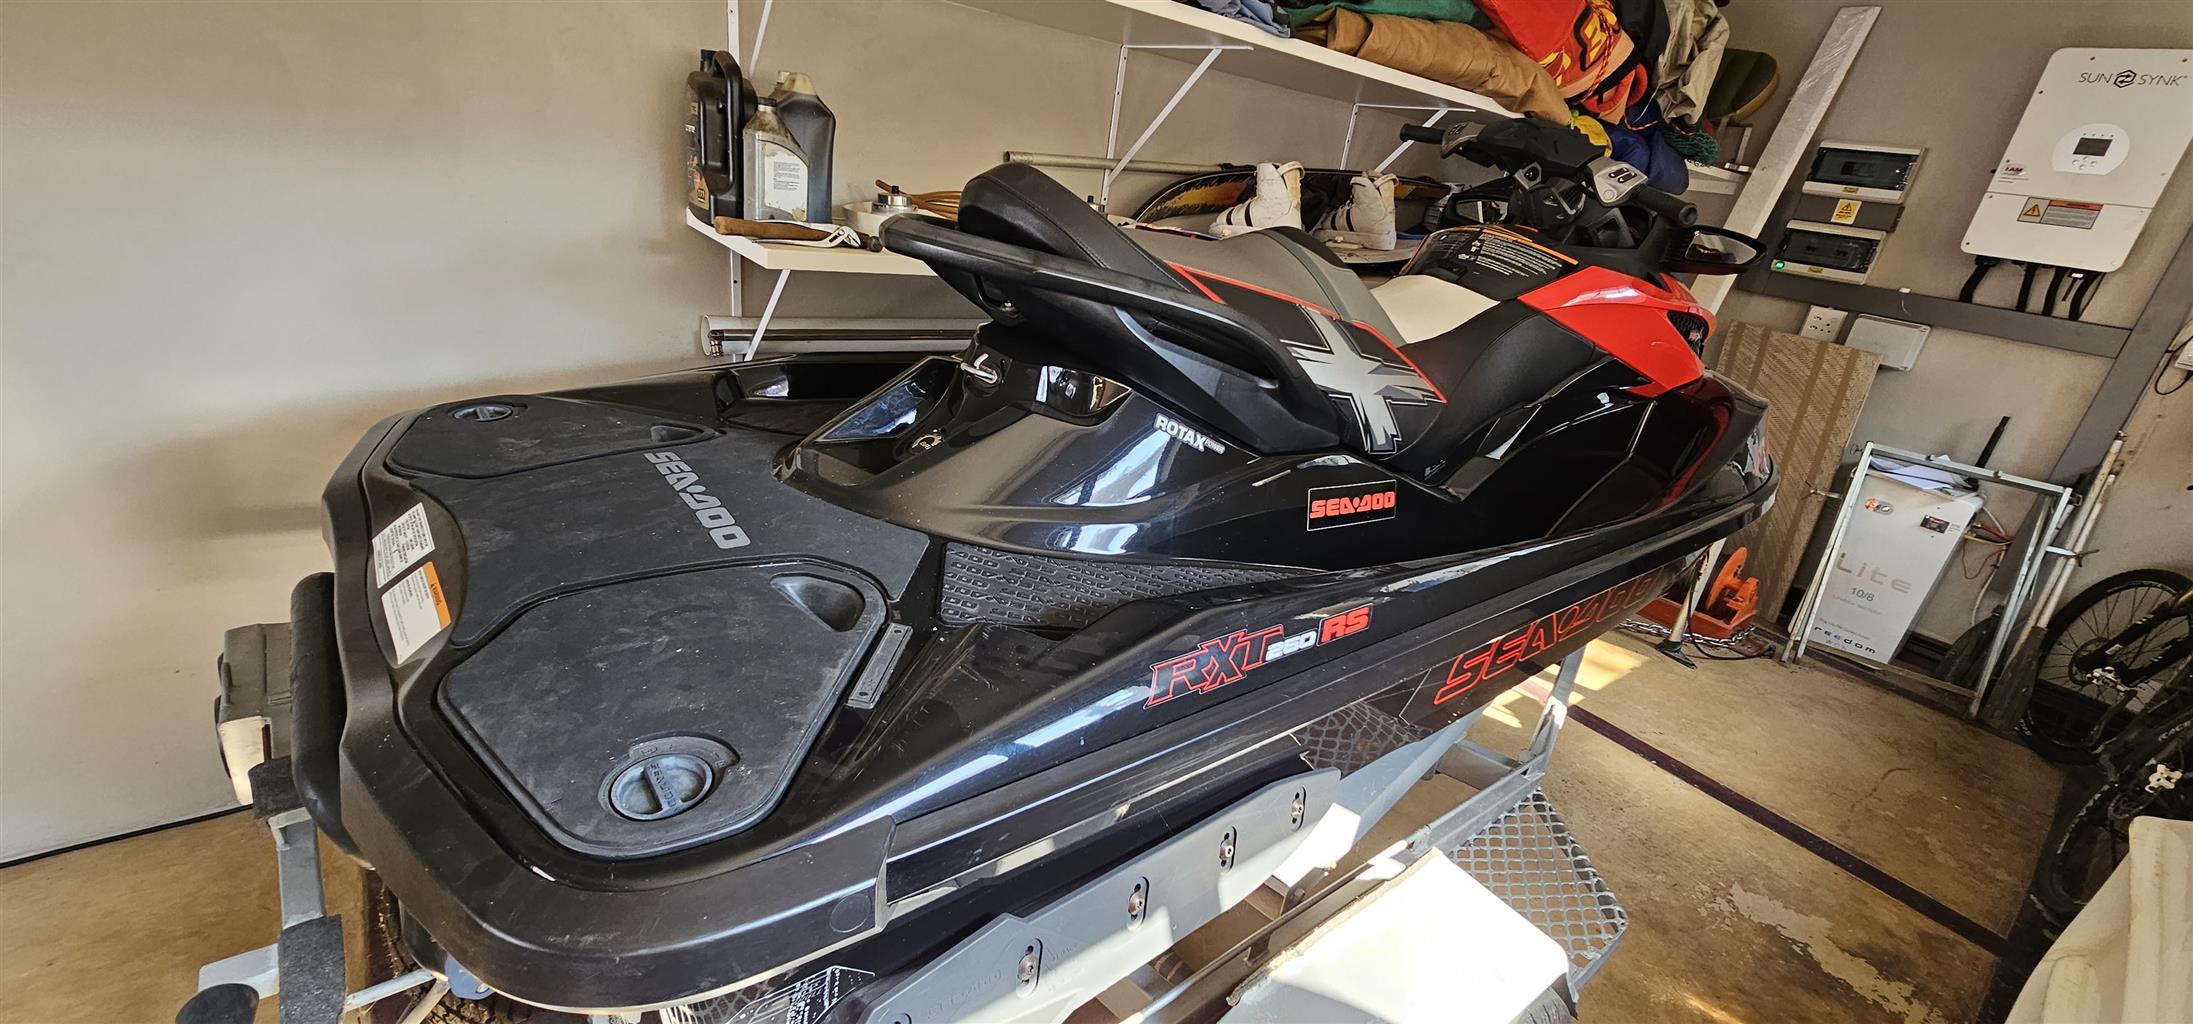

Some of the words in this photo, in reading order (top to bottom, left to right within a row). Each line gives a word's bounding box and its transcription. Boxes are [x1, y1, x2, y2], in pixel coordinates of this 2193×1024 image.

[2078, 72, 2113, 84] SUN
[2138, 74, 2183, 87] SYNK
[1154, 413, 1207, 453] ROTAX
[1850, 586, 1875, 602] 10/8
[1814, 626, 1876, 654] reedom
[1144, 624, 1284, 709] RXT
[1265, 630, 1317, 662] 260
[1320, 606, 1370, 645] RS
